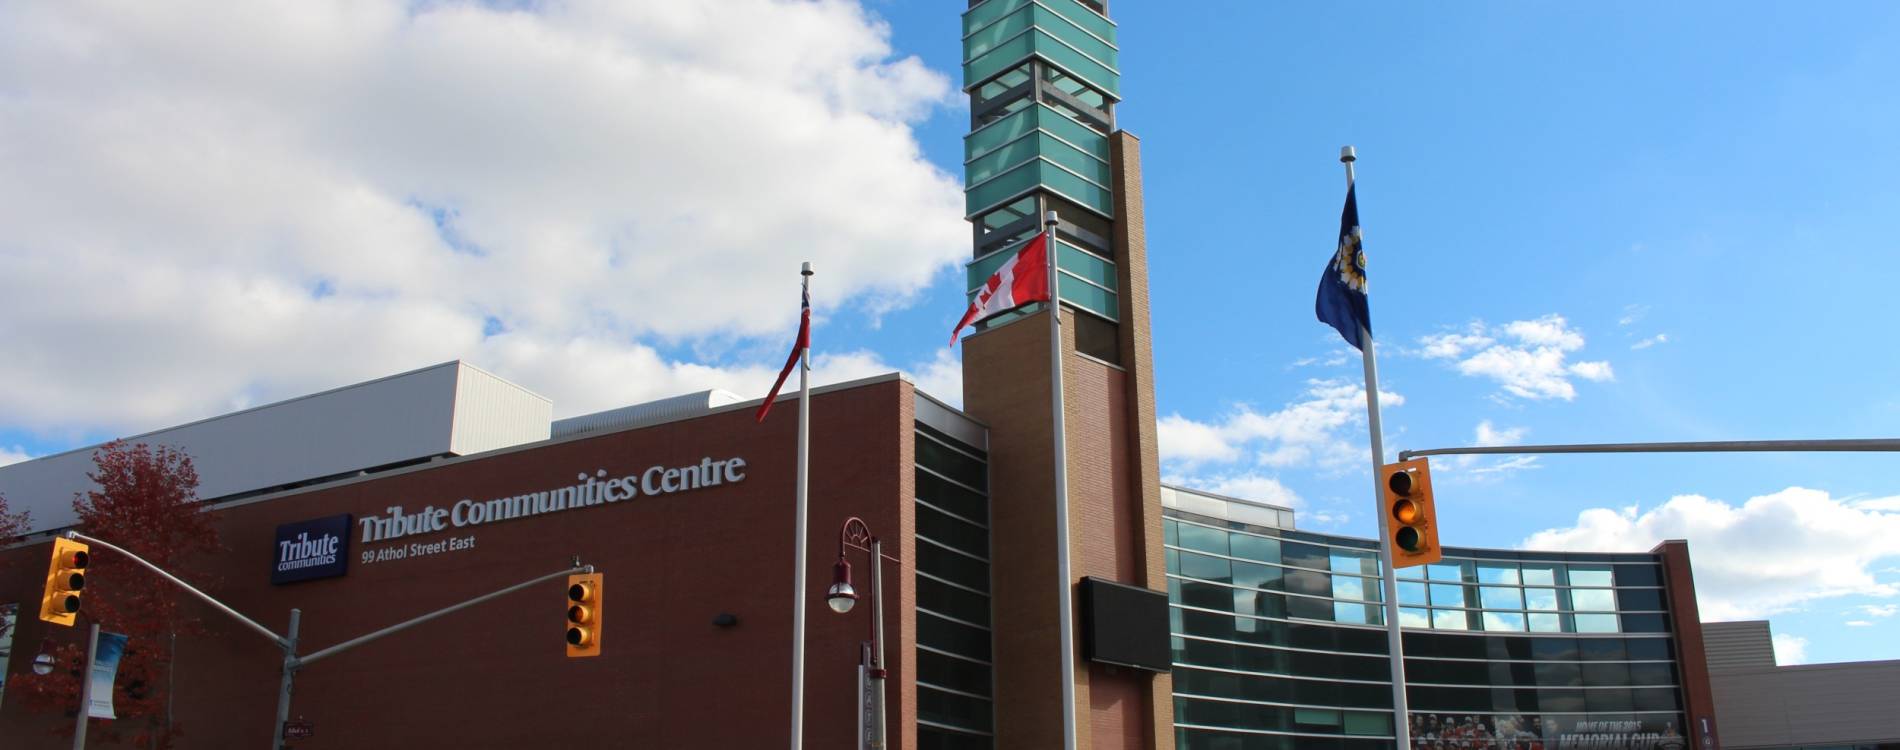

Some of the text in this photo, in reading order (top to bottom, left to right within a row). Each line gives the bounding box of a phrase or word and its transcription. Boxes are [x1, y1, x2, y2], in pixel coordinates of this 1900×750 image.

[359, 456, 746, 543] Tribute Communities Centre
[279, 532, 339, 562] Tribute
[361, 535, 476, 564] 99 Athol Street East
[278, 553, 336, 572] communities
[1701, 719, 1709, 734] 1
[1559, 732, 1660, 750] MEMORIAL CUP
